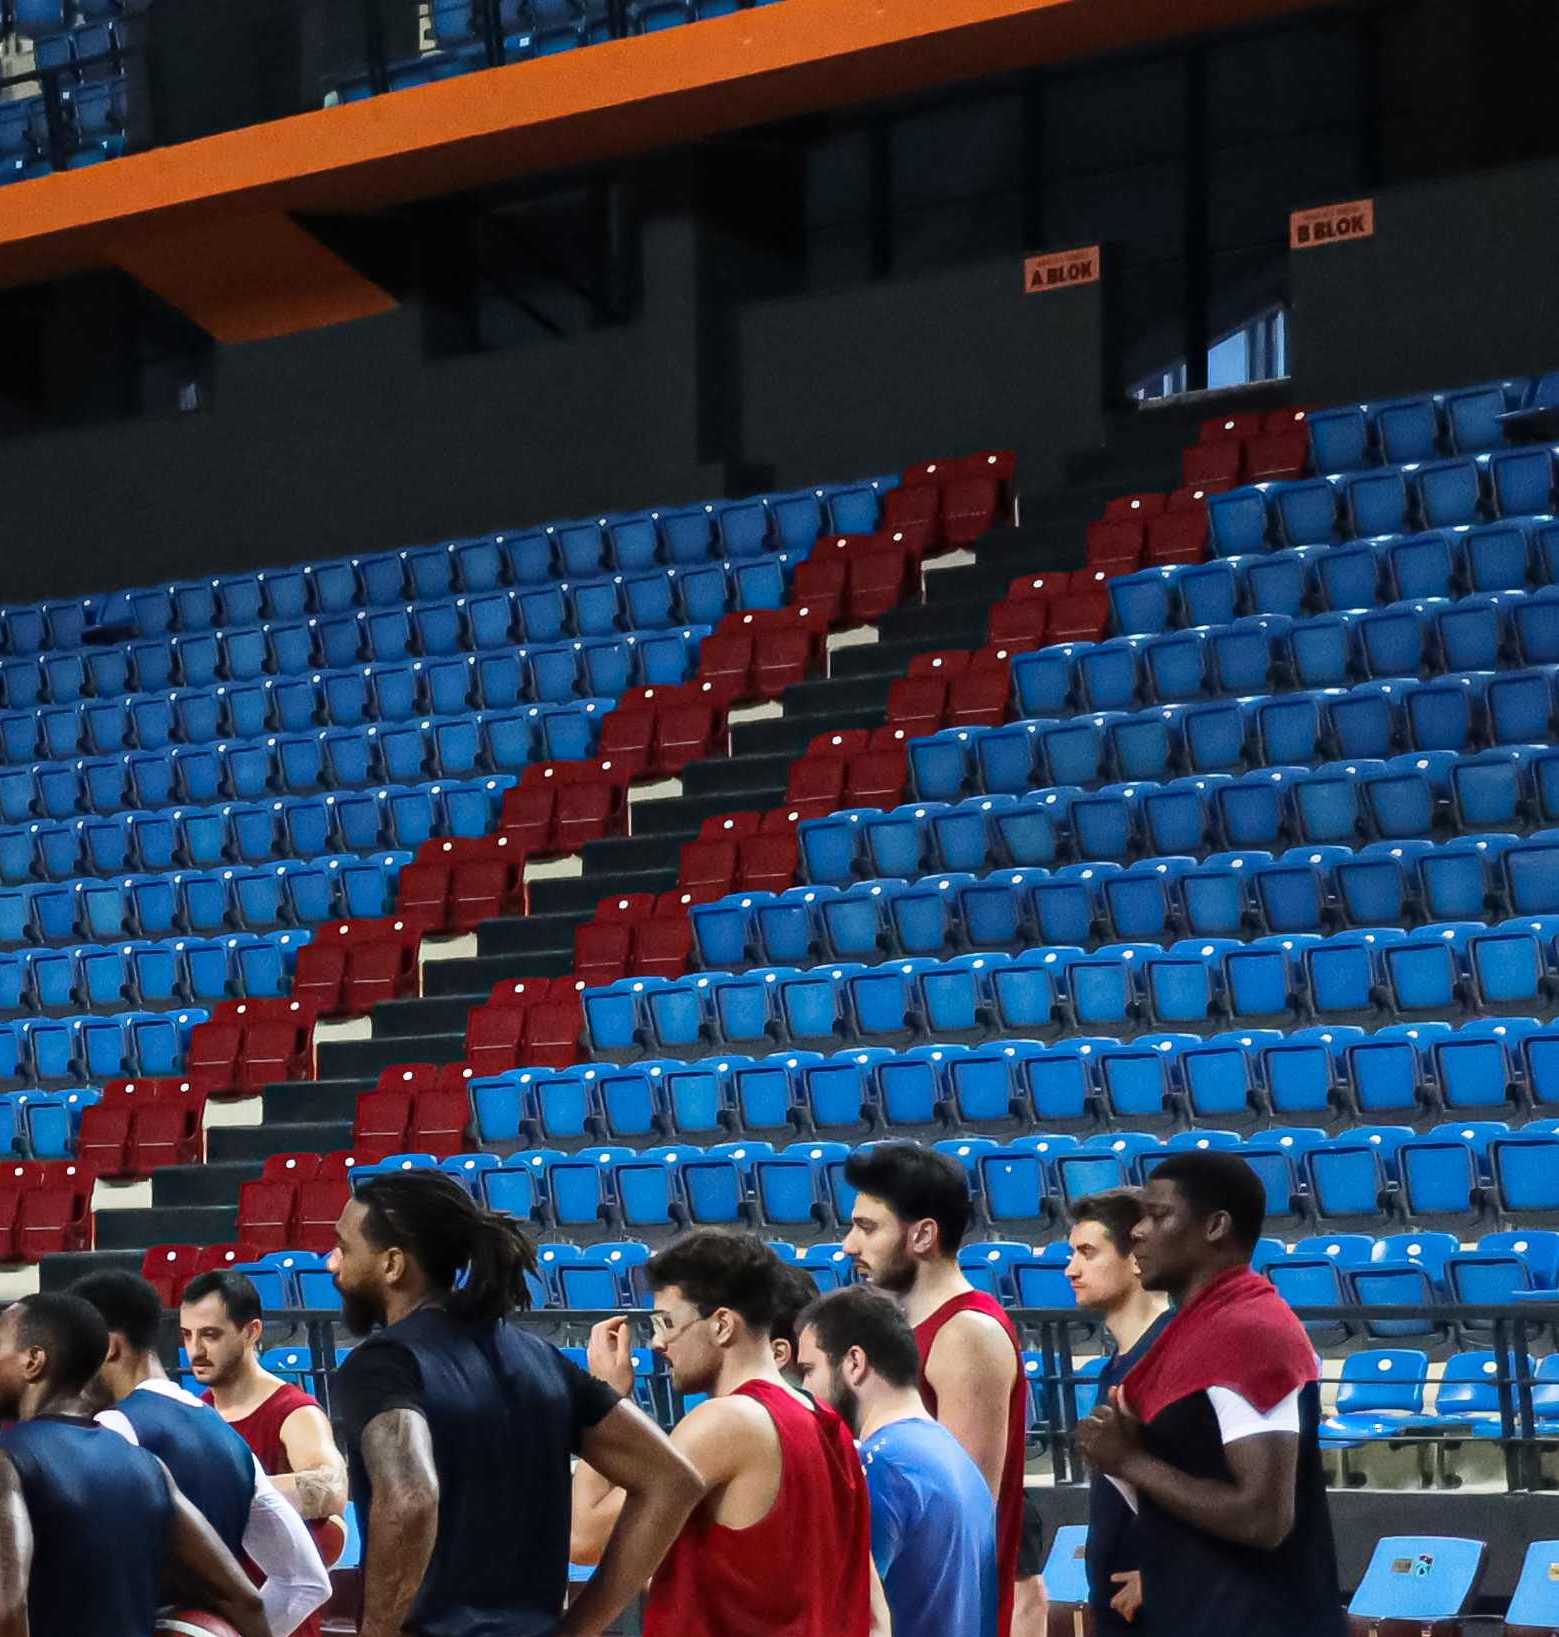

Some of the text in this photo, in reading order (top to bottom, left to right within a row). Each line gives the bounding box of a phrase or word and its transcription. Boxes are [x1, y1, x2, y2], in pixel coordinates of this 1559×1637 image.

[1314, 213, 1365, 240] BLOK
[1030, 261, 1091, 288] A BLOK
